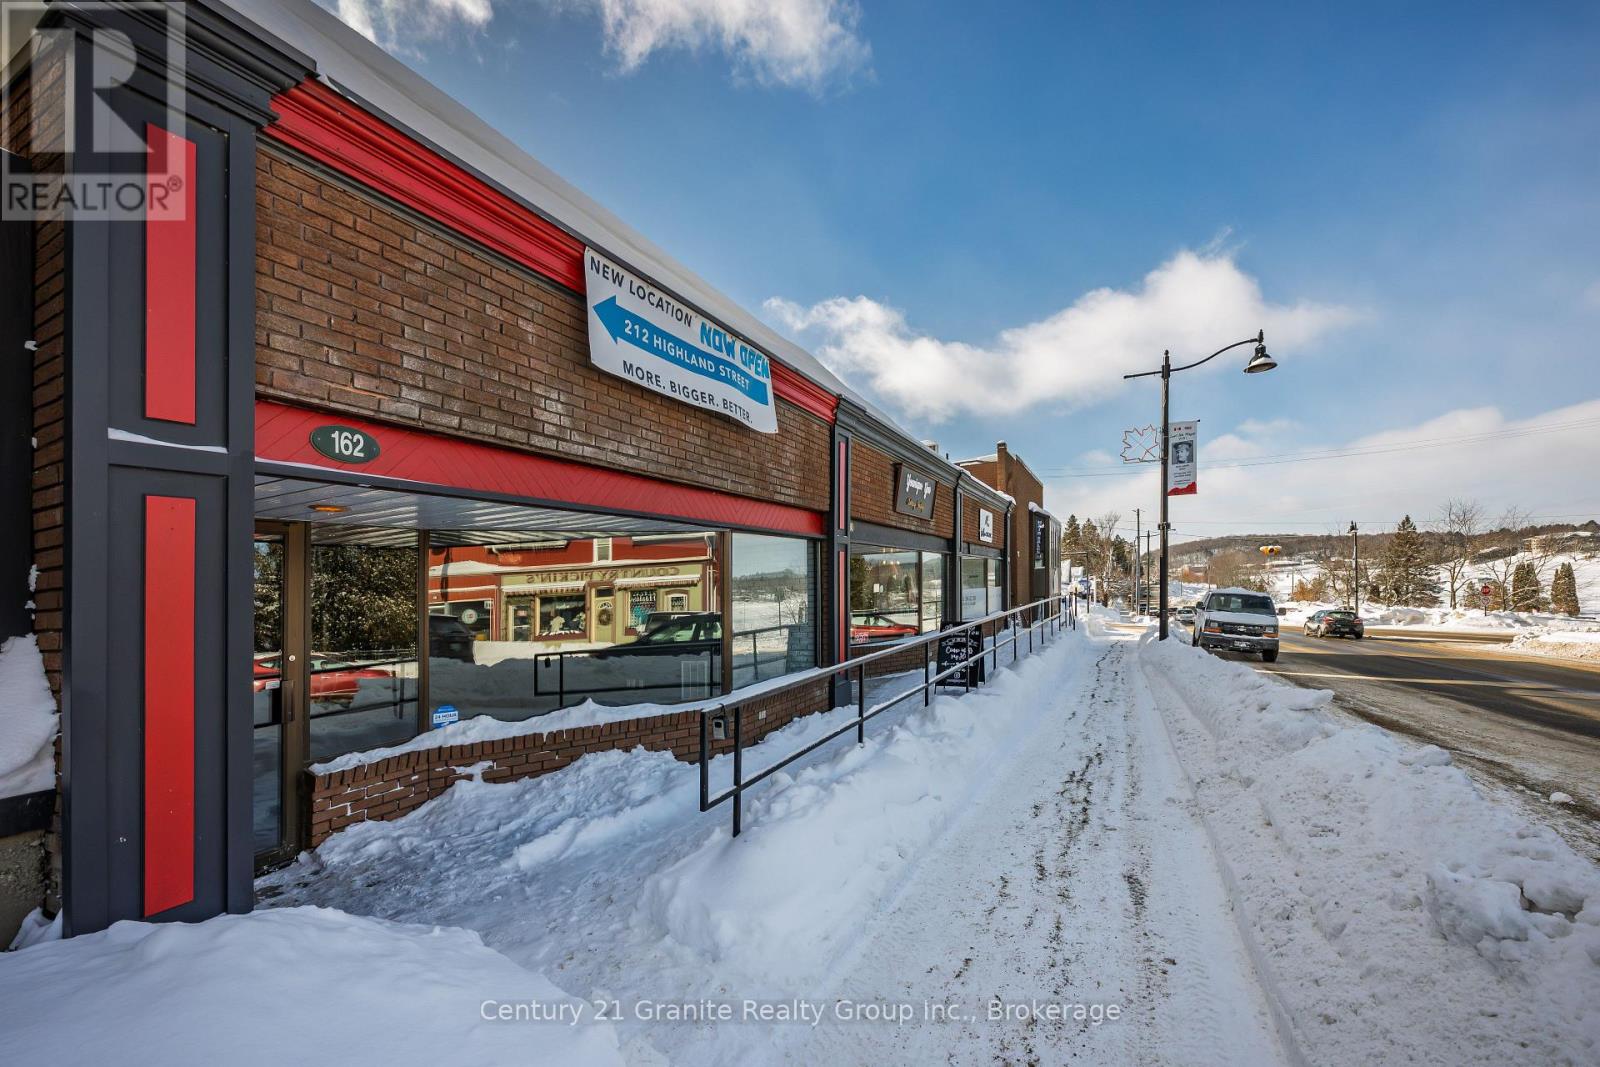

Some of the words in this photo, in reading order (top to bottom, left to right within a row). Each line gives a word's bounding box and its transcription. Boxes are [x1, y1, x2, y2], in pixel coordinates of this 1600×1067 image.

[590, 255, 625, 288] NEW
[629, 280, 693, 328] LOCATION
[700, 321, 737, 361] NOW
[739, 344, 770, 379] OPEN
[624, 319, 649, 343] 212
[653, 334, 715, 373] HIGHLAND
[719, 364, 750, 391] STREET
[622, 360, 666, 390] MORE.
[669, 380, 719, 408] BIGGER.
[722, 398, 753, 424] BETTER.
[331, 428, 365, 458] 162
